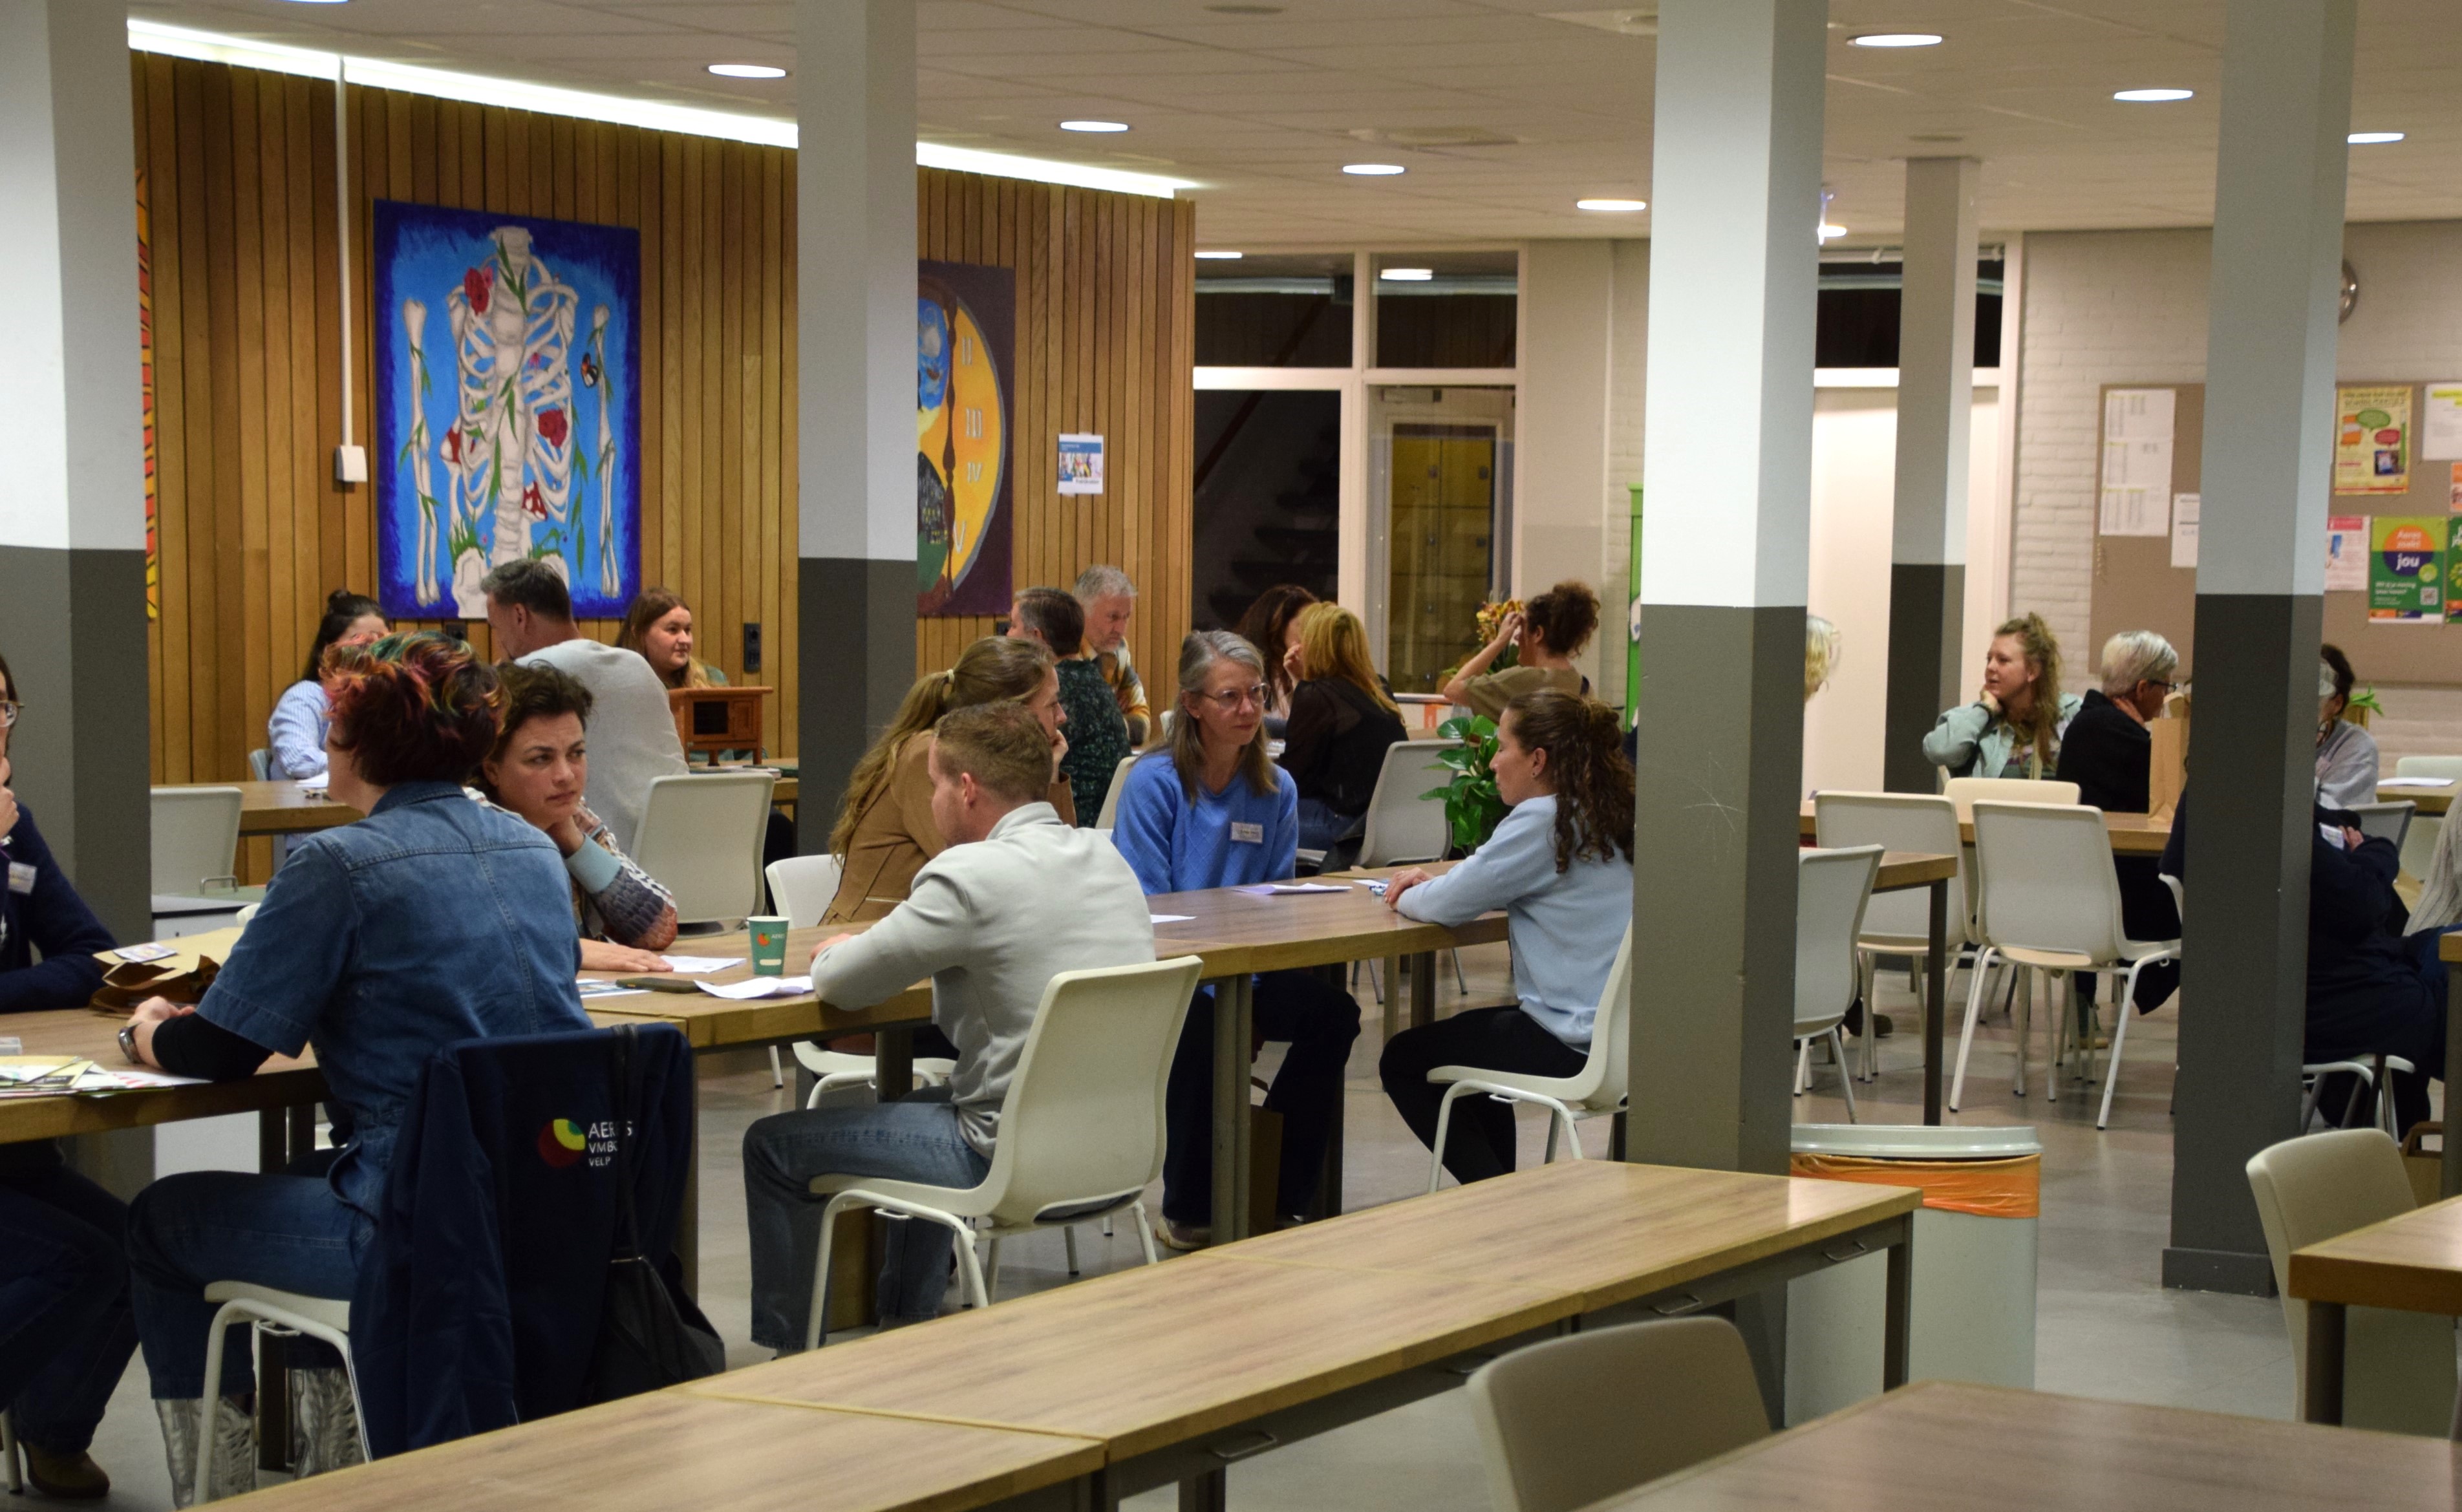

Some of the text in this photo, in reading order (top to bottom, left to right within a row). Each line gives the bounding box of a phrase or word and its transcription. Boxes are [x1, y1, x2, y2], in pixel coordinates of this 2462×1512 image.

[966, 407, 983, 438] III
[967, 462, 983, 483] IV
[2395, 553, 2421, 571] jou
[588, 1156, 611, 1166] VELP
